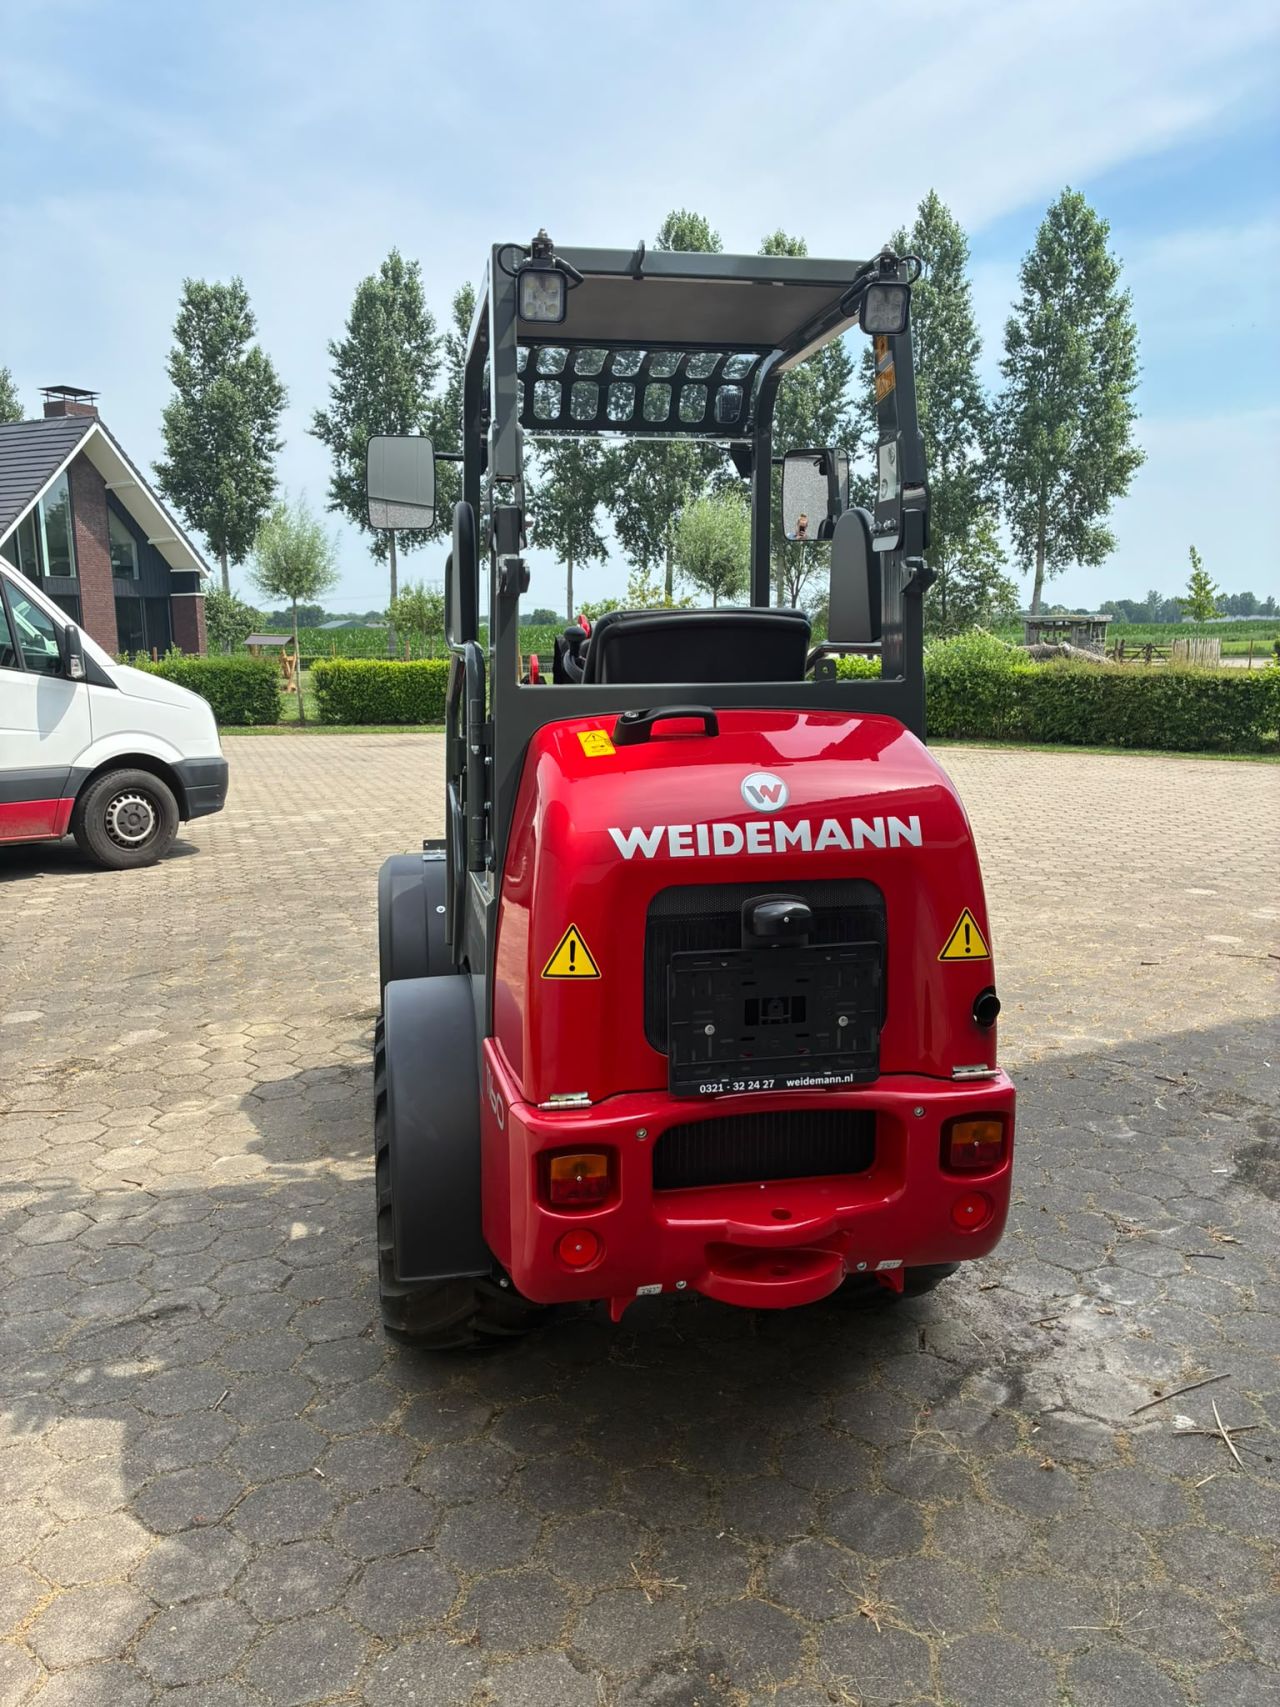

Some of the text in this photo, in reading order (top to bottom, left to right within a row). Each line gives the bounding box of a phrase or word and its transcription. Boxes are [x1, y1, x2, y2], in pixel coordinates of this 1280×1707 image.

[608, 815, 923, 860] WEIDEMANN
[699, 1083, 724, 1094] 0321
[732, 1082, 745, 1091] 32
[747, 1080, 761, 1090] 24
[762, 1079, 775, 1089] 27
[786, 1073, 854, 1087] weidemann.nl
